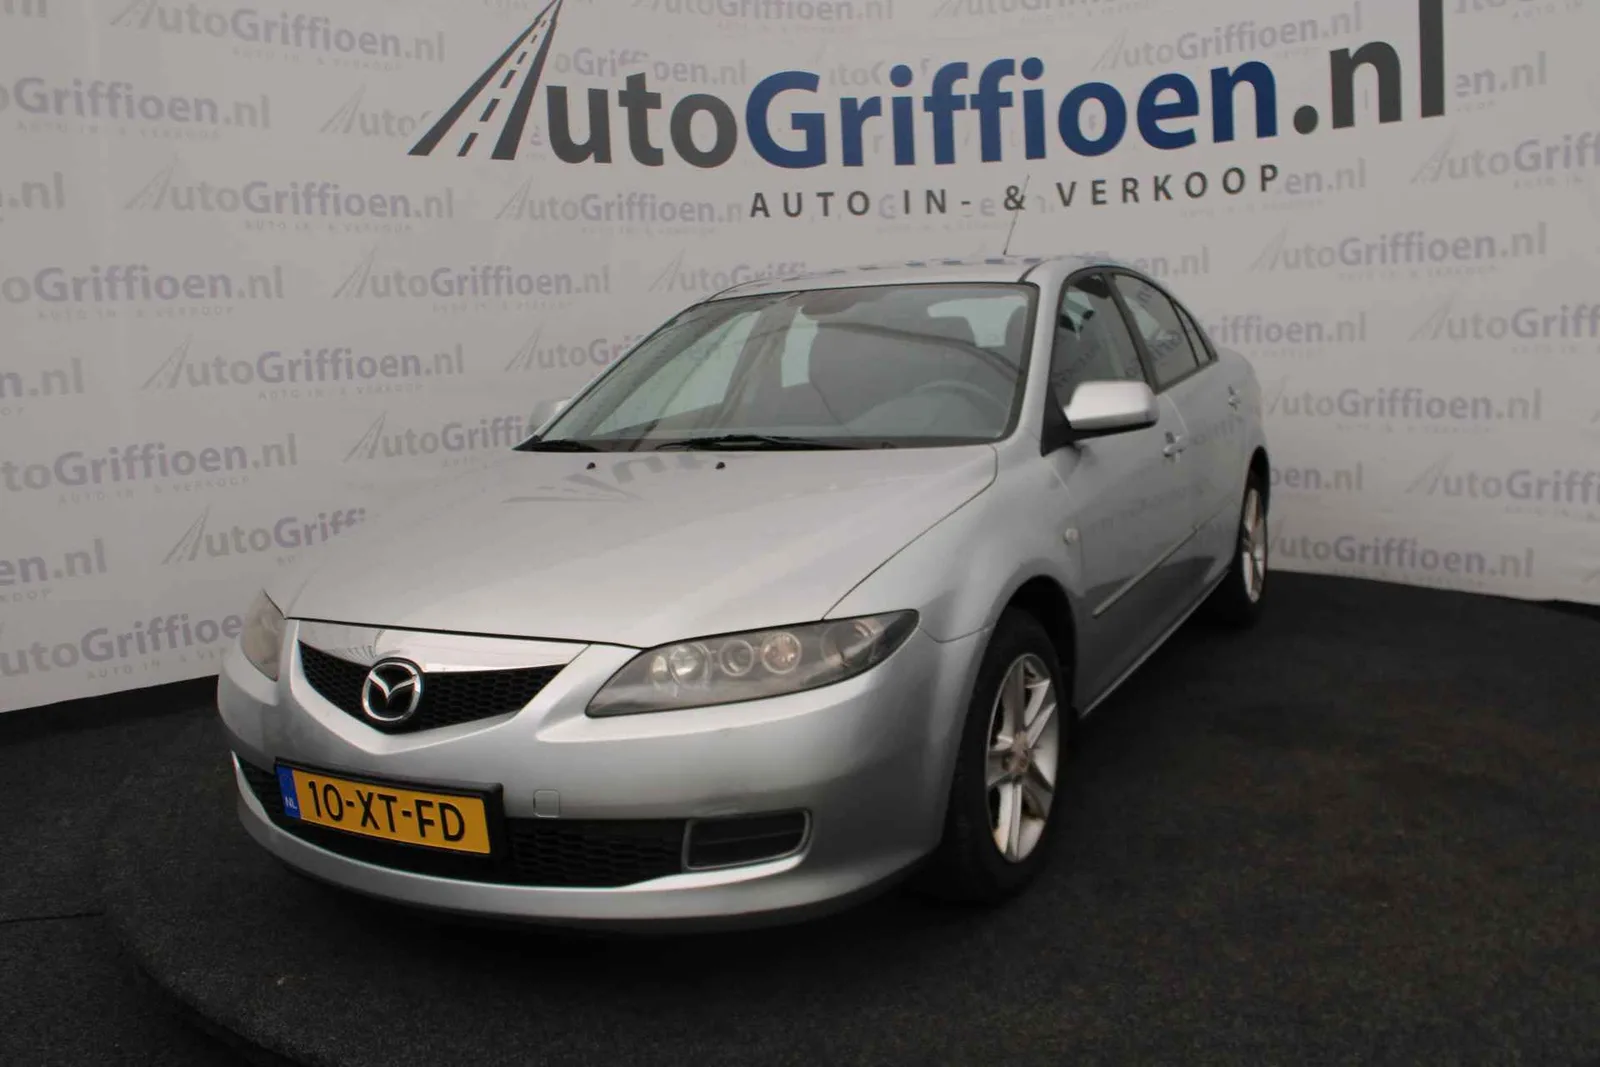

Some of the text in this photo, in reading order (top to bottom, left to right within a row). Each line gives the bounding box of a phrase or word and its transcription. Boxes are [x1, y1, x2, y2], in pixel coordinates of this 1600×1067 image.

[750, 191, 870, 218] AUTO
[1003, 184, 1027, 210] &
[1056, 164, 1279, 208] VERKOOP
[285, 796, 298, 810] NL
[308, 780, 466, 843] 10-XT-FD
